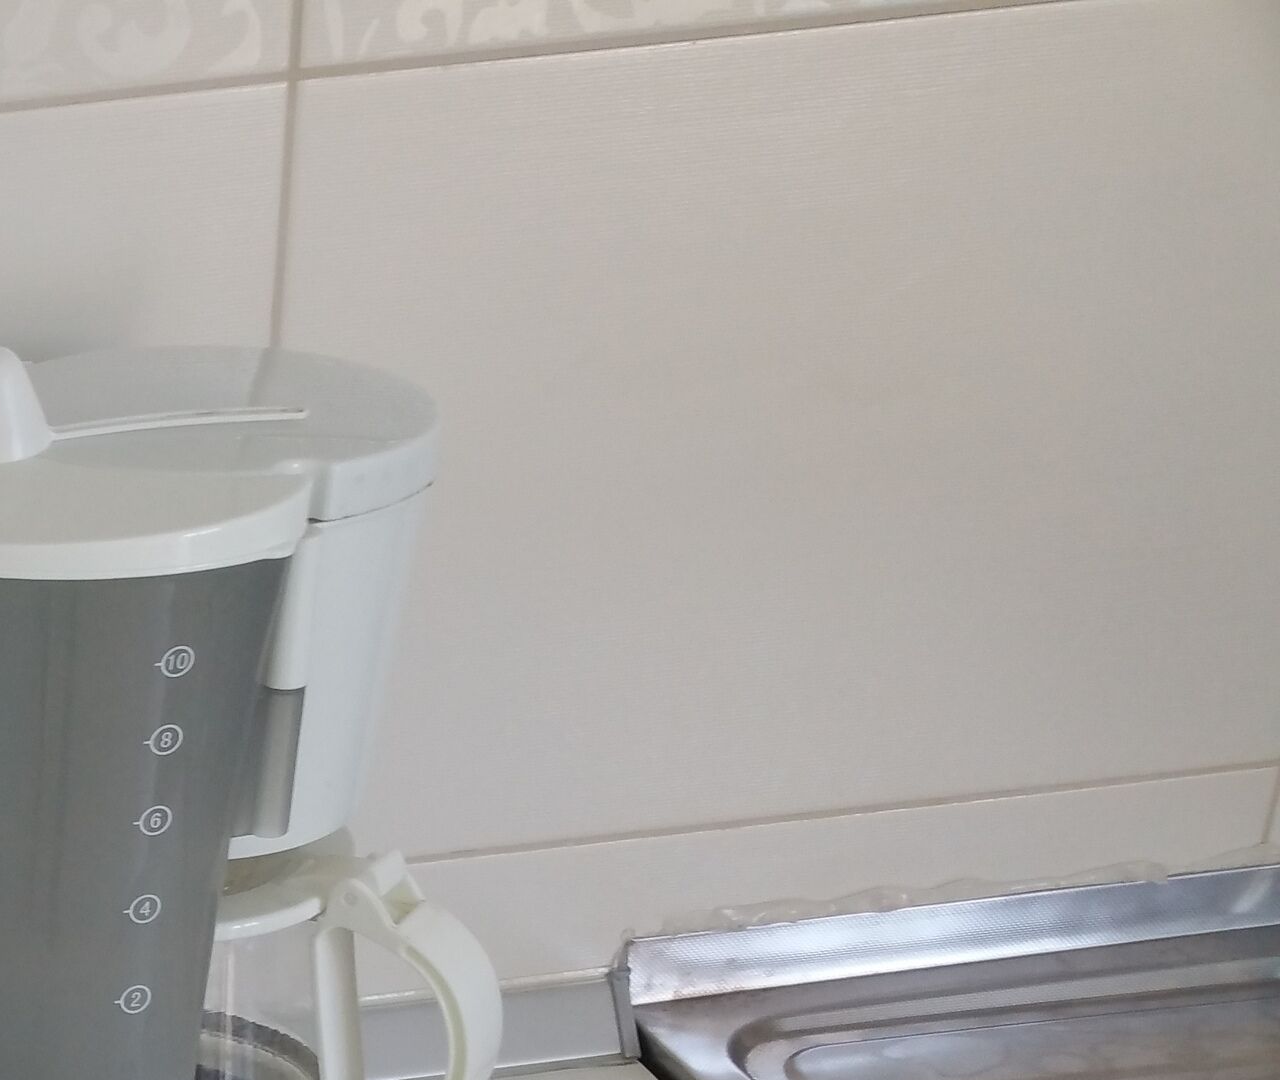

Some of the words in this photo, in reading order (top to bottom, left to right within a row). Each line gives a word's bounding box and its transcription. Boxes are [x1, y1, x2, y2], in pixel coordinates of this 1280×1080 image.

[168, 653, 189, 670] 10
[160, 732, 173, 748] 8
[150, 813, 162, 829] 6
[139, 902, 152, 917] 4
[131, 992, 142, 1008] 2
